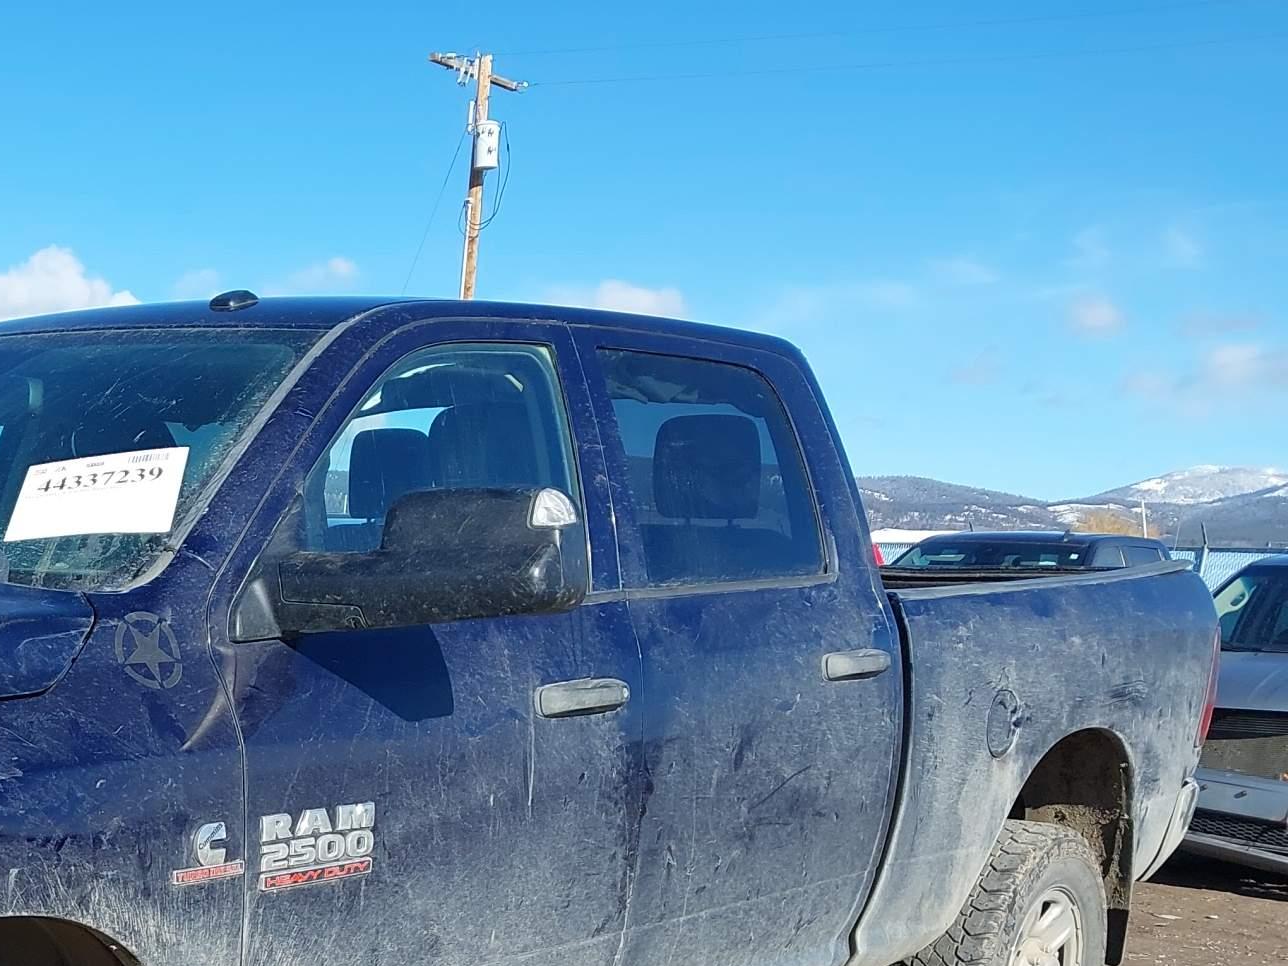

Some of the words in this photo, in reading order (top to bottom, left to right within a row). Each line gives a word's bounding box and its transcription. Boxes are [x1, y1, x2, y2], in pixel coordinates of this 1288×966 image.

[37, 466, 164, 492] 44337239
[261, 801, 376, 842] RAM
[261, 829, 374, 872] 2500
[266, 869, 322, 888] HEAVY
[324, 861, 370, 878] DUTY
